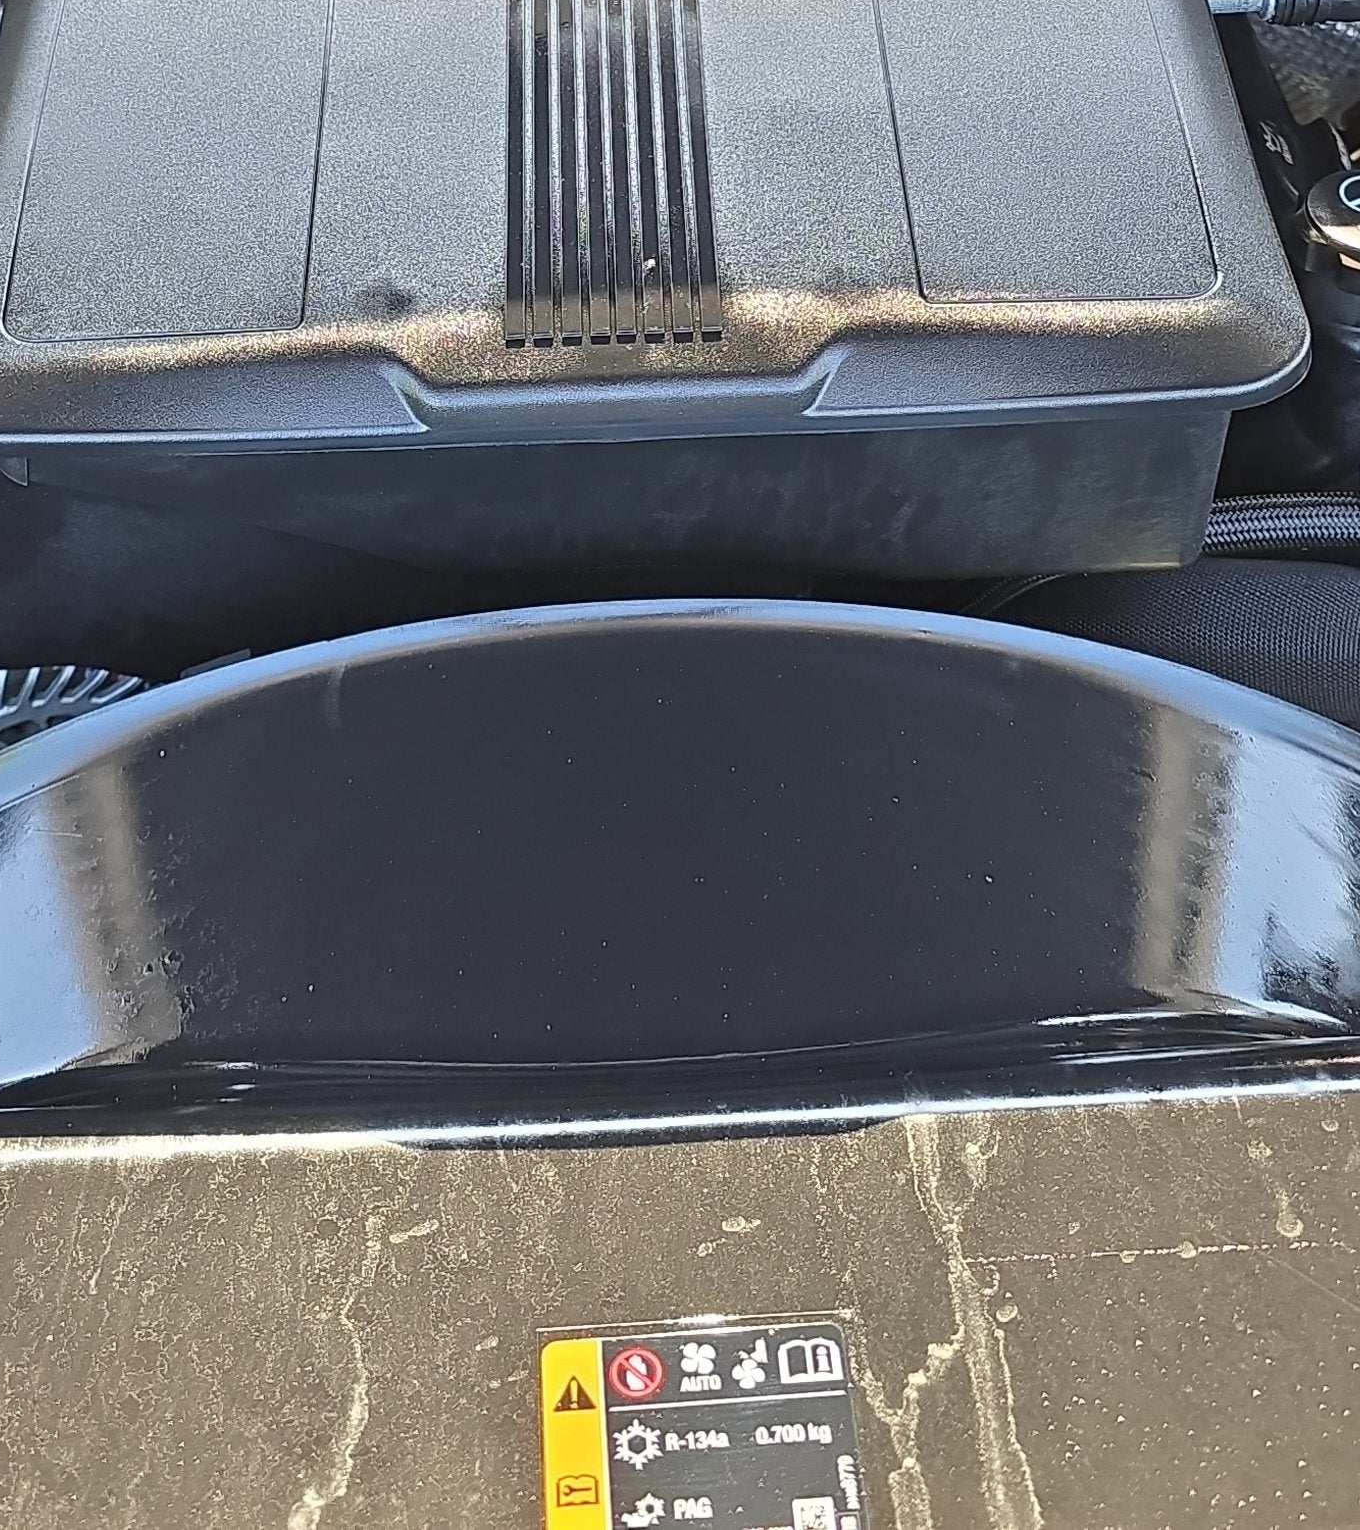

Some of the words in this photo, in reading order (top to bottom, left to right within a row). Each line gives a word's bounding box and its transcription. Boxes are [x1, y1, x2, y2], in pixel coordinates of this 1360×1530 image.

[680, 1375, 722, 1392] AUTO
[665, 1430, 730, 1452] R-134a
[755, 1423, 806, 1445] 0.700
[807, 1422, 833, 1444] kg
[673, 1497, 714, 1520] PAG
